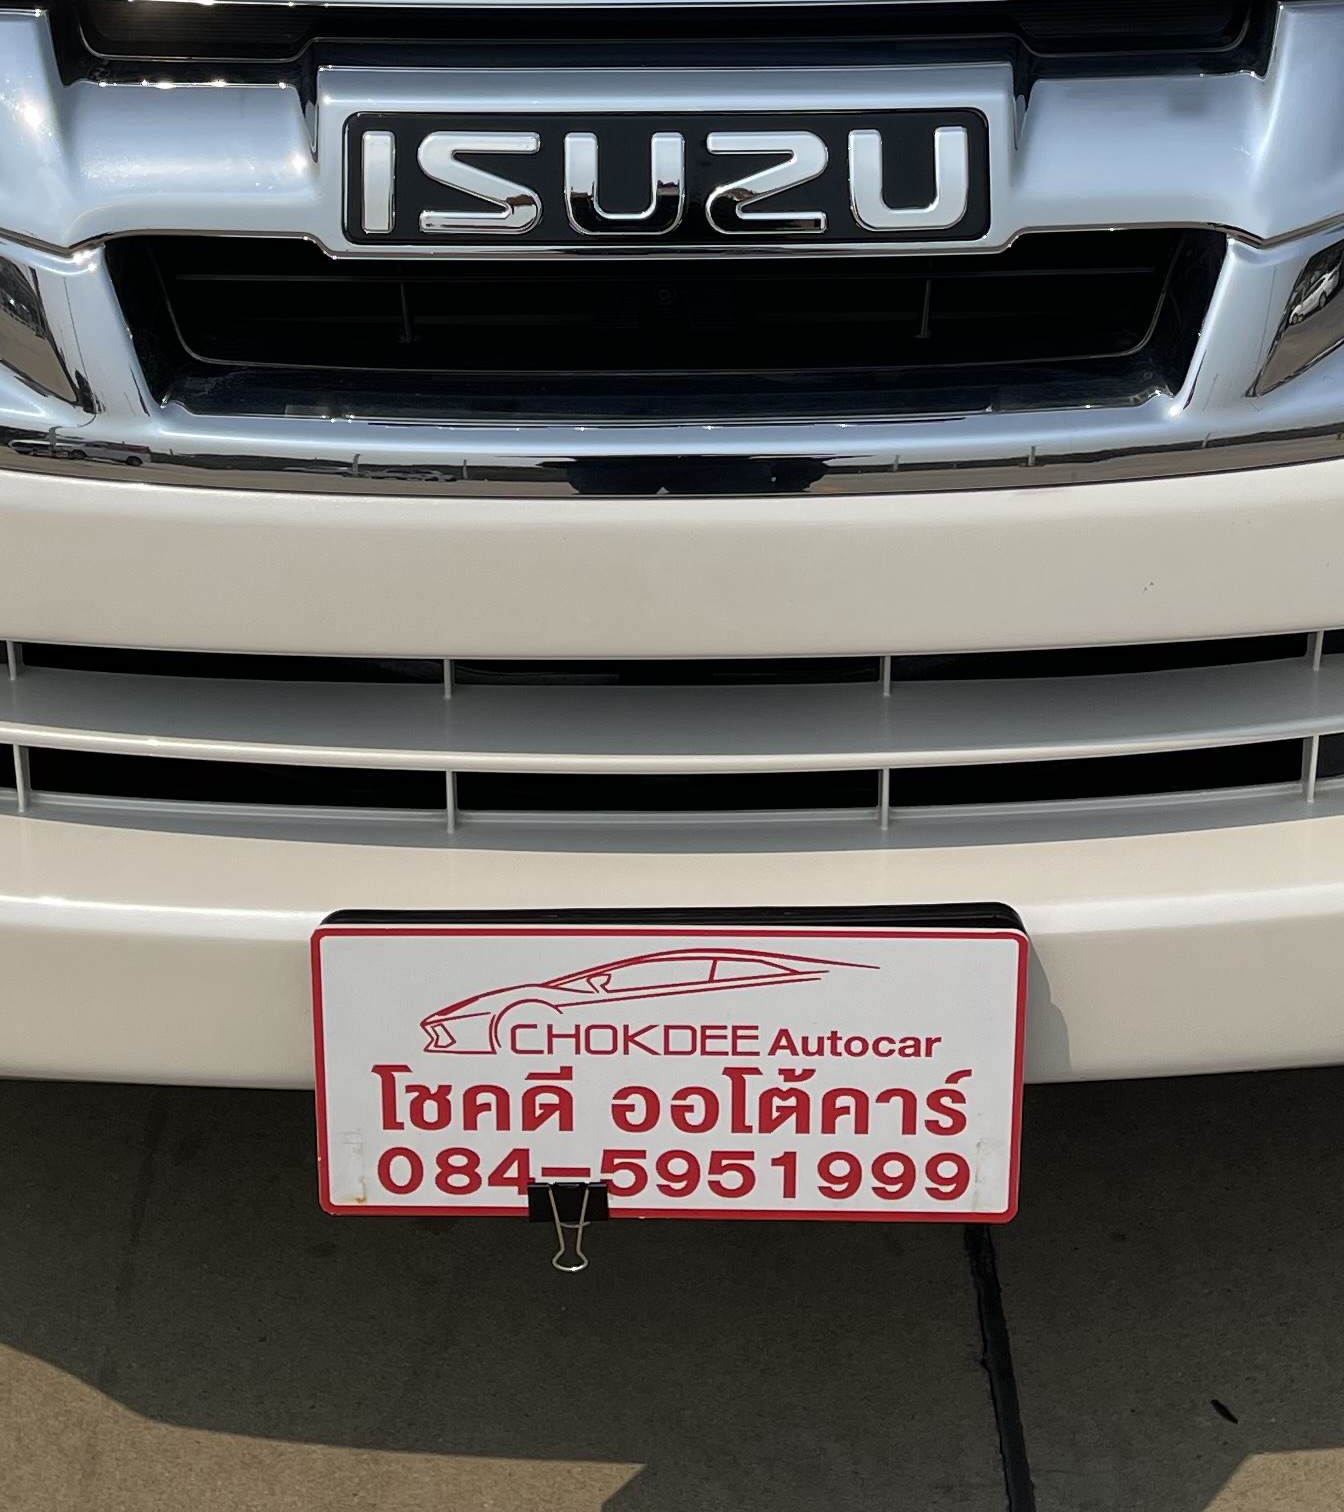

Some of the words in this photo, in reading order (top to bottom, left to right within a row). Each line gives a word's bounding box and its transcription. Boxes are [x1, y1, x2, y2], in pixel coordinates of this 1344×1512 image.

[362, 126, 968, 235] ISUZU
[509, 1023, 760, 1056] CHOKDEE
[767, 1028, 942, 1059] Autocar
[371, 1063, 574, 1133] โชคดี
[610, 1065, 972, 1137] ออโต้คาร์
[376, 1145, 971, 1201] 084-5951999
